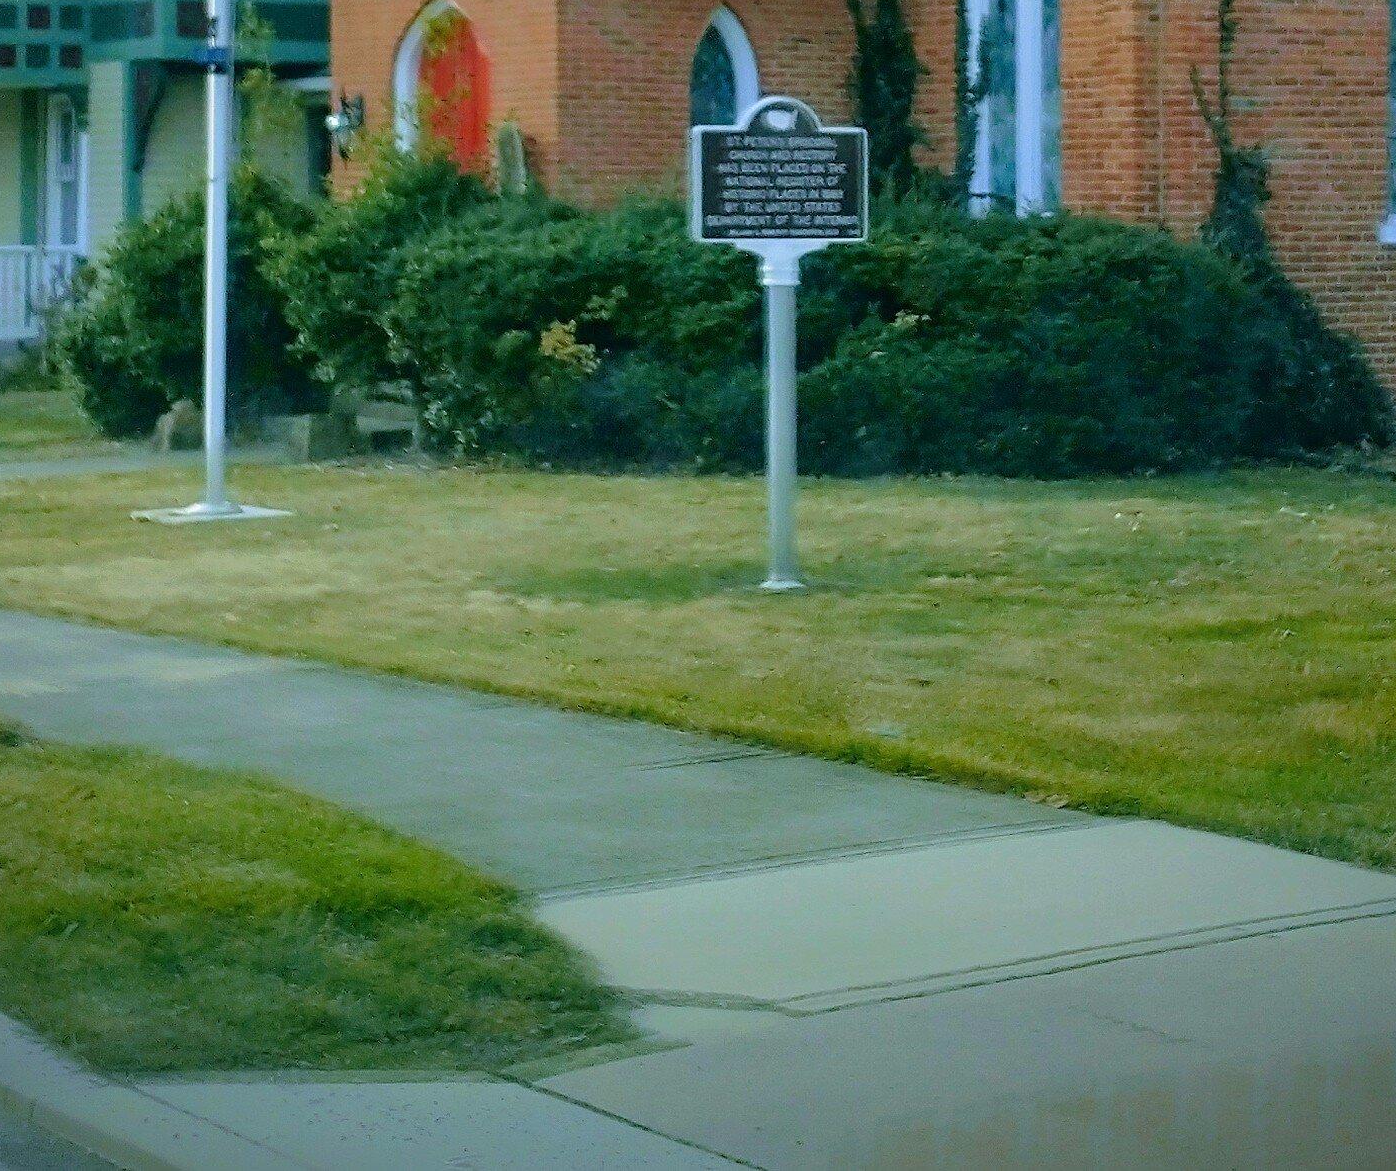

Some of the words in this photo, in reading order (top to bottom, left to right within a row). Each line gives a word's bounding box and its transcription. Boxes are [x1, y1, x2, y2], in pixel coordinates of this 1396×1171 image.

[728, 150, 770, 161] CHURCH
[770, 150, 791, 161] AND
[717, 163, 739, 174] HAS
[741, 163, 768, 174] BEEN
[770, 163, 810, 174] PLACED
[811, 163, 825, 174] ON
[827, 163, 848, 174] THE
[724, 175, 774, 187] NATIONAL
[775, 175, 825, 187] REGISTER
[825, 175, 839, 187] OF
[722, 189, 768, 200] HISTORIC
[768, 189, 808, 200] PLACES
[808, 189, 820, 200] IN
[724, 201, 739, 213] BY
[743, 201, 764, 213] THE
[765, 201, 802, 213] UNITED
[804, 201, 842, 213] STATES
[705, 215, 772, 226] DEPARTMENT
[775, 215, 790, 226] OF
[792, 215, 813, 226] THE
[813, 215, 859, 226] INTERIOR
